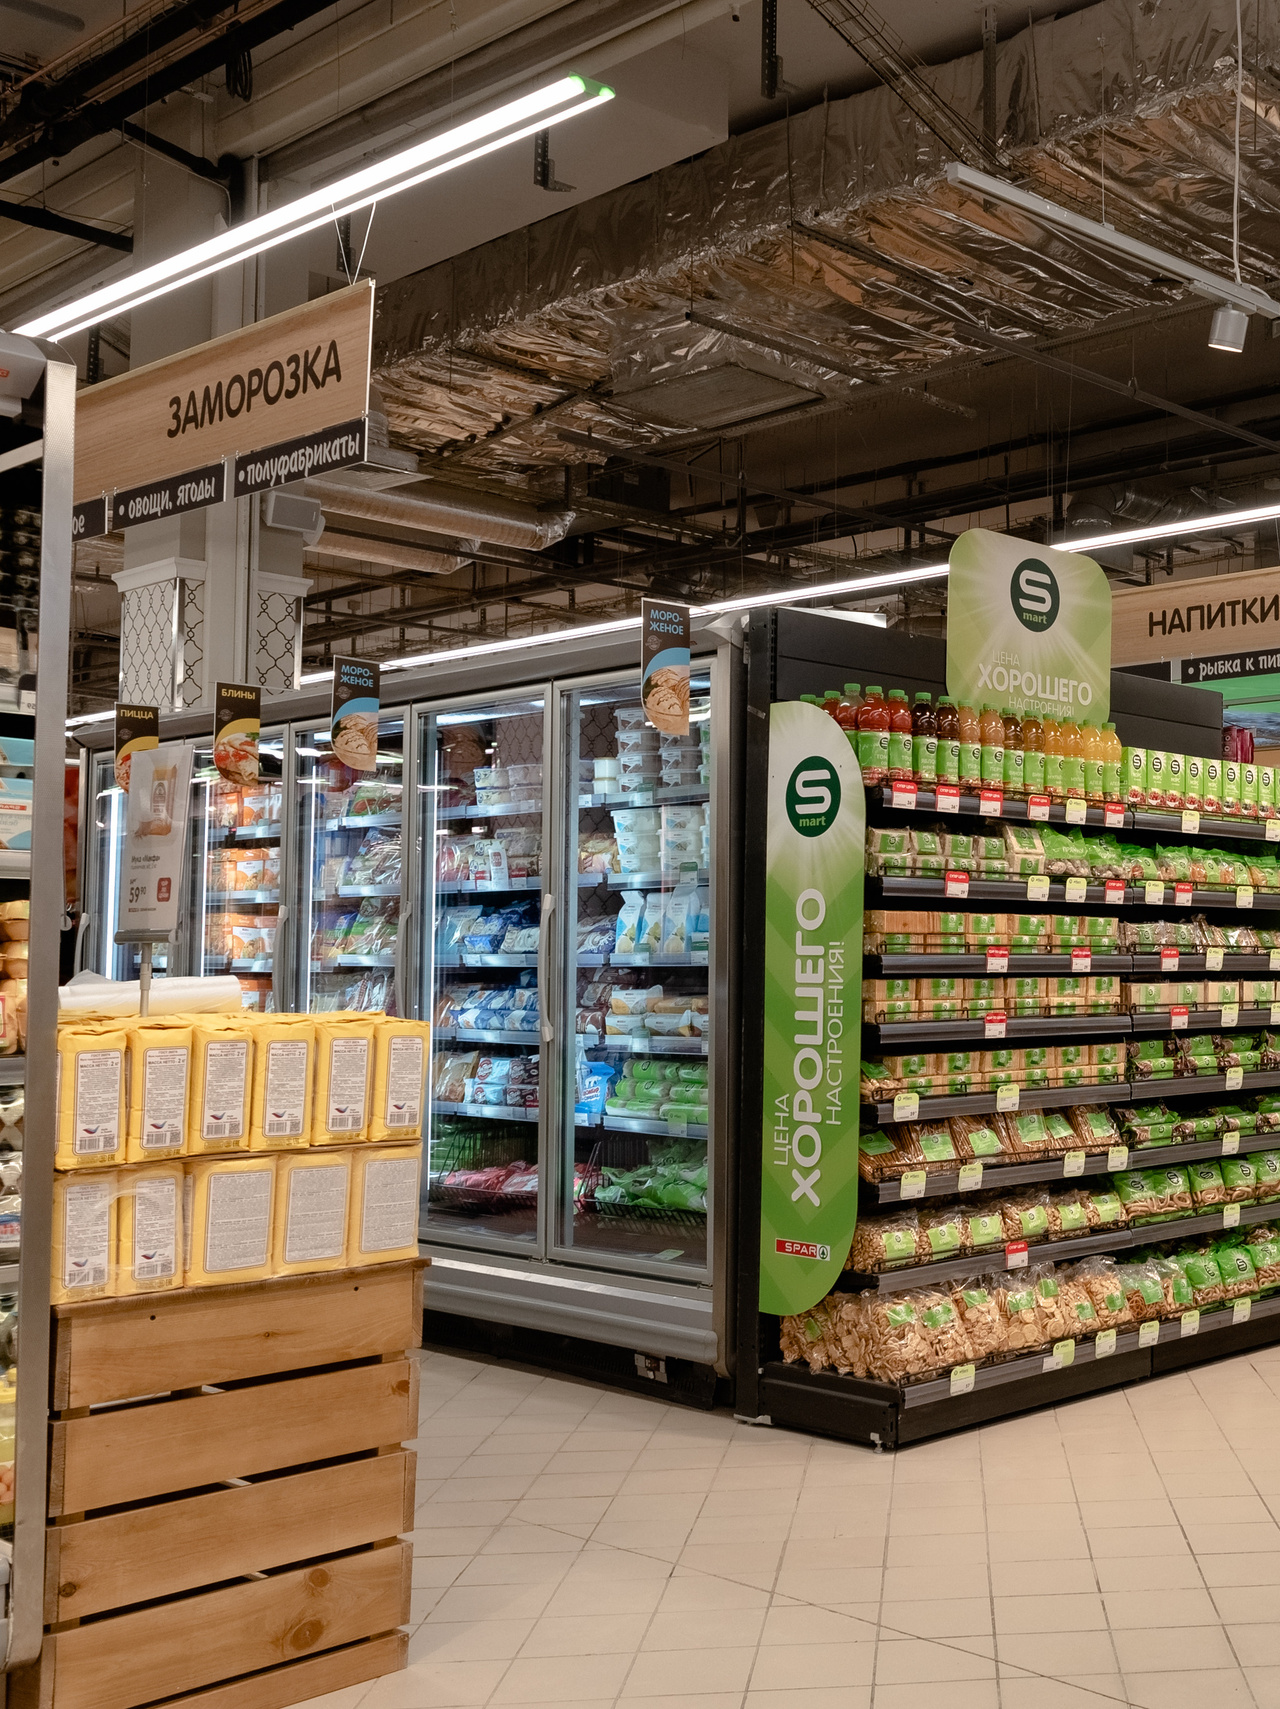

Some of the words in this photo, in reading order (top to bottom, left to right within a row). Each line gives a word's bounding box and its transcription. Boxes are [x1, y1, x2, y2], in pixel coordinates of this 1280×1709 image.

[167, 339, 342, 439] ЗАМОРОЗКА
[246, 432, 361, 487] полуфабрикаты
[128, 491, 173, 519] овощи,
[177, 477, 216, 507] ягоды
[1018, 569, 1052, 613] S
[650, 608, 684, 622] МОРО-
[1022, 611, 1048, 625] mart
[1148, 594, 1280, 638] НАПИТКИ
[650, 620, 684, 636] ЖЕНОЕ
[992, 650, 1021, 668] ЦЕНА
[340, 664, 374, 677] МОРО-
[1199, 658, 1242, 682] рыбка
[1246, 660, 1255, 671] к
[340, 674, 374, 688] ЖЕНОЕ
[977, 662, 1093, 706] ХОРОШЕГО
[221, 688, 256, 700] БЛИНЫ
[120, 709, 154, 720] ПИЦЦА
[794, 768, 832, 815] S
[798, 814, 827, 829] mart
[128, 886, 140, 904] 59
[825, 940, 845, 1126] НАСТРОЕНИЯ!
[790, 887, 827, 1207] ХОРОШЕГО
[773, 1092, 791, 1167] ЦЕНА
[784, 1242, 817, 1256] SPAR
